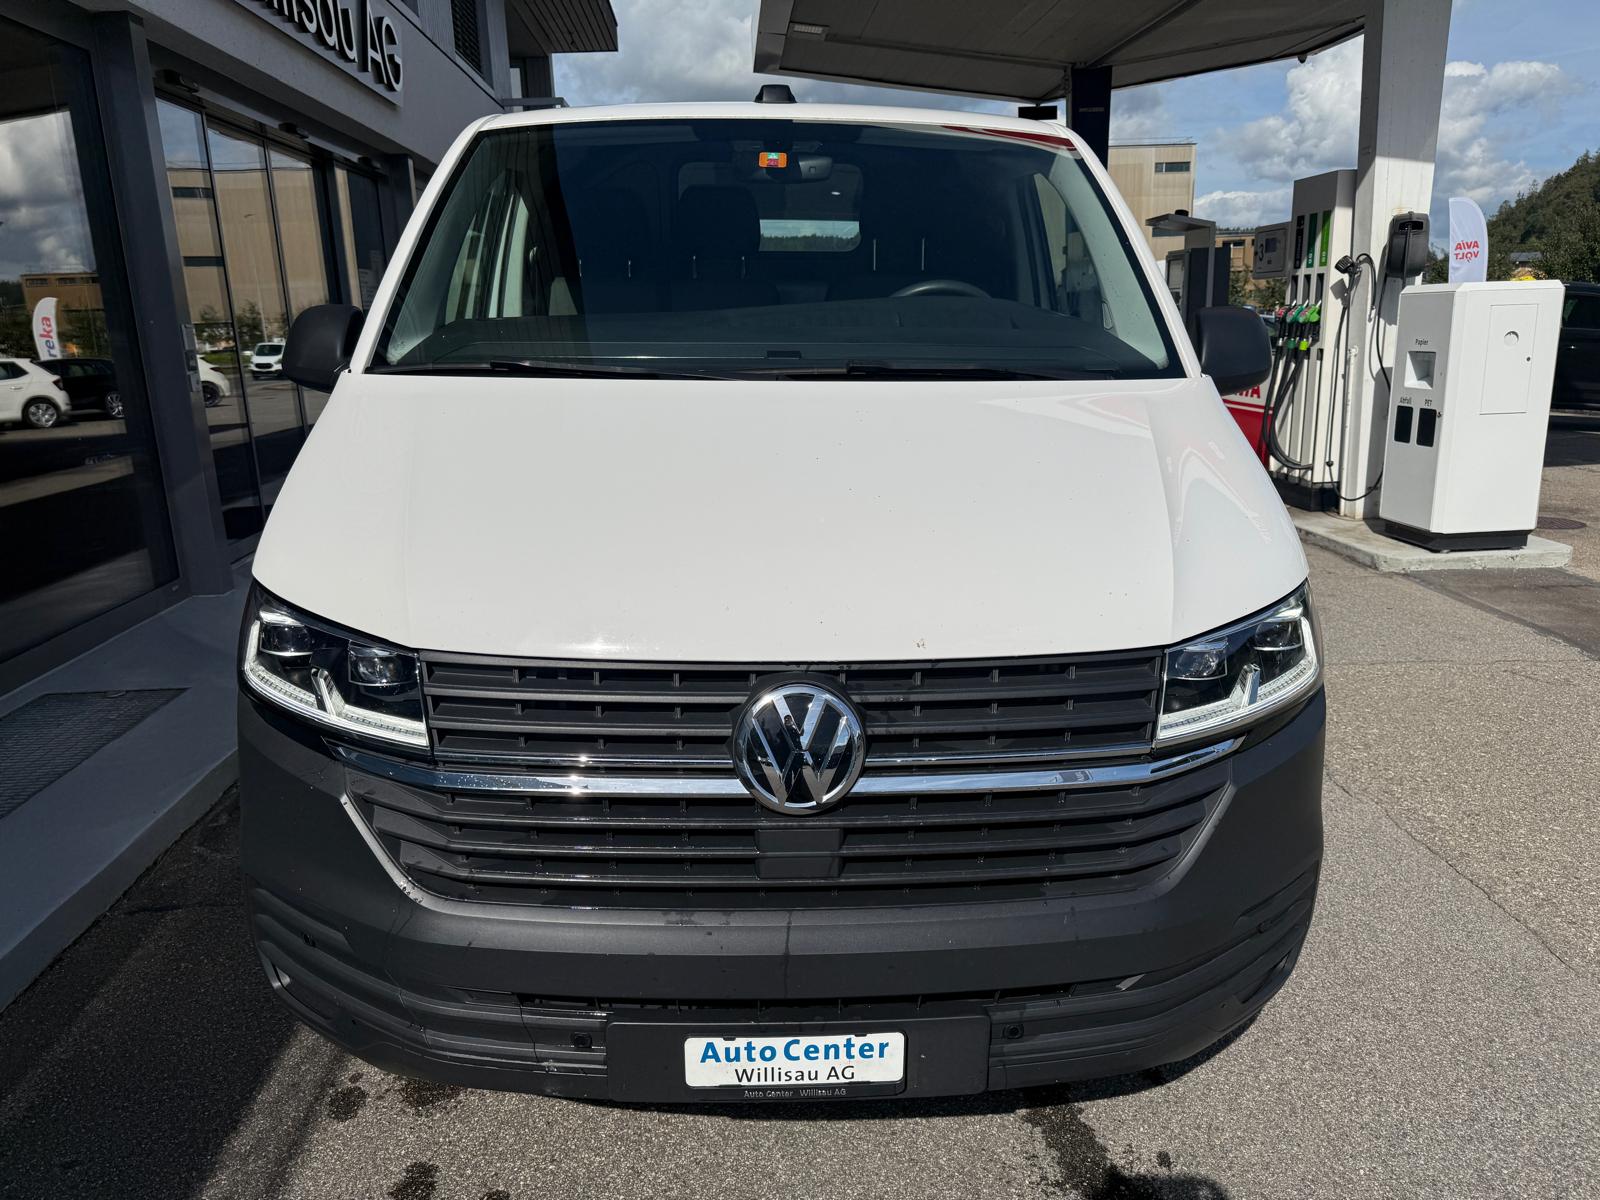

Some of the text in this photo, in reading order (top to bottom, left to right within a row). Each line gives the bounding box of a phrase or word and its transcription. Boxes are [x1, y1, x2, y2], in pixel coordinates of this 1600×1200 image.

[363, 0, 403, 92] AG
[40, 316, 57, 358] reka
[700, 1037, 889, 1063] Auto Center
[735, 1066, 855, 1083] Willisau AG
[744, 1088, 846, 1098] Auto Center Willisau AG
